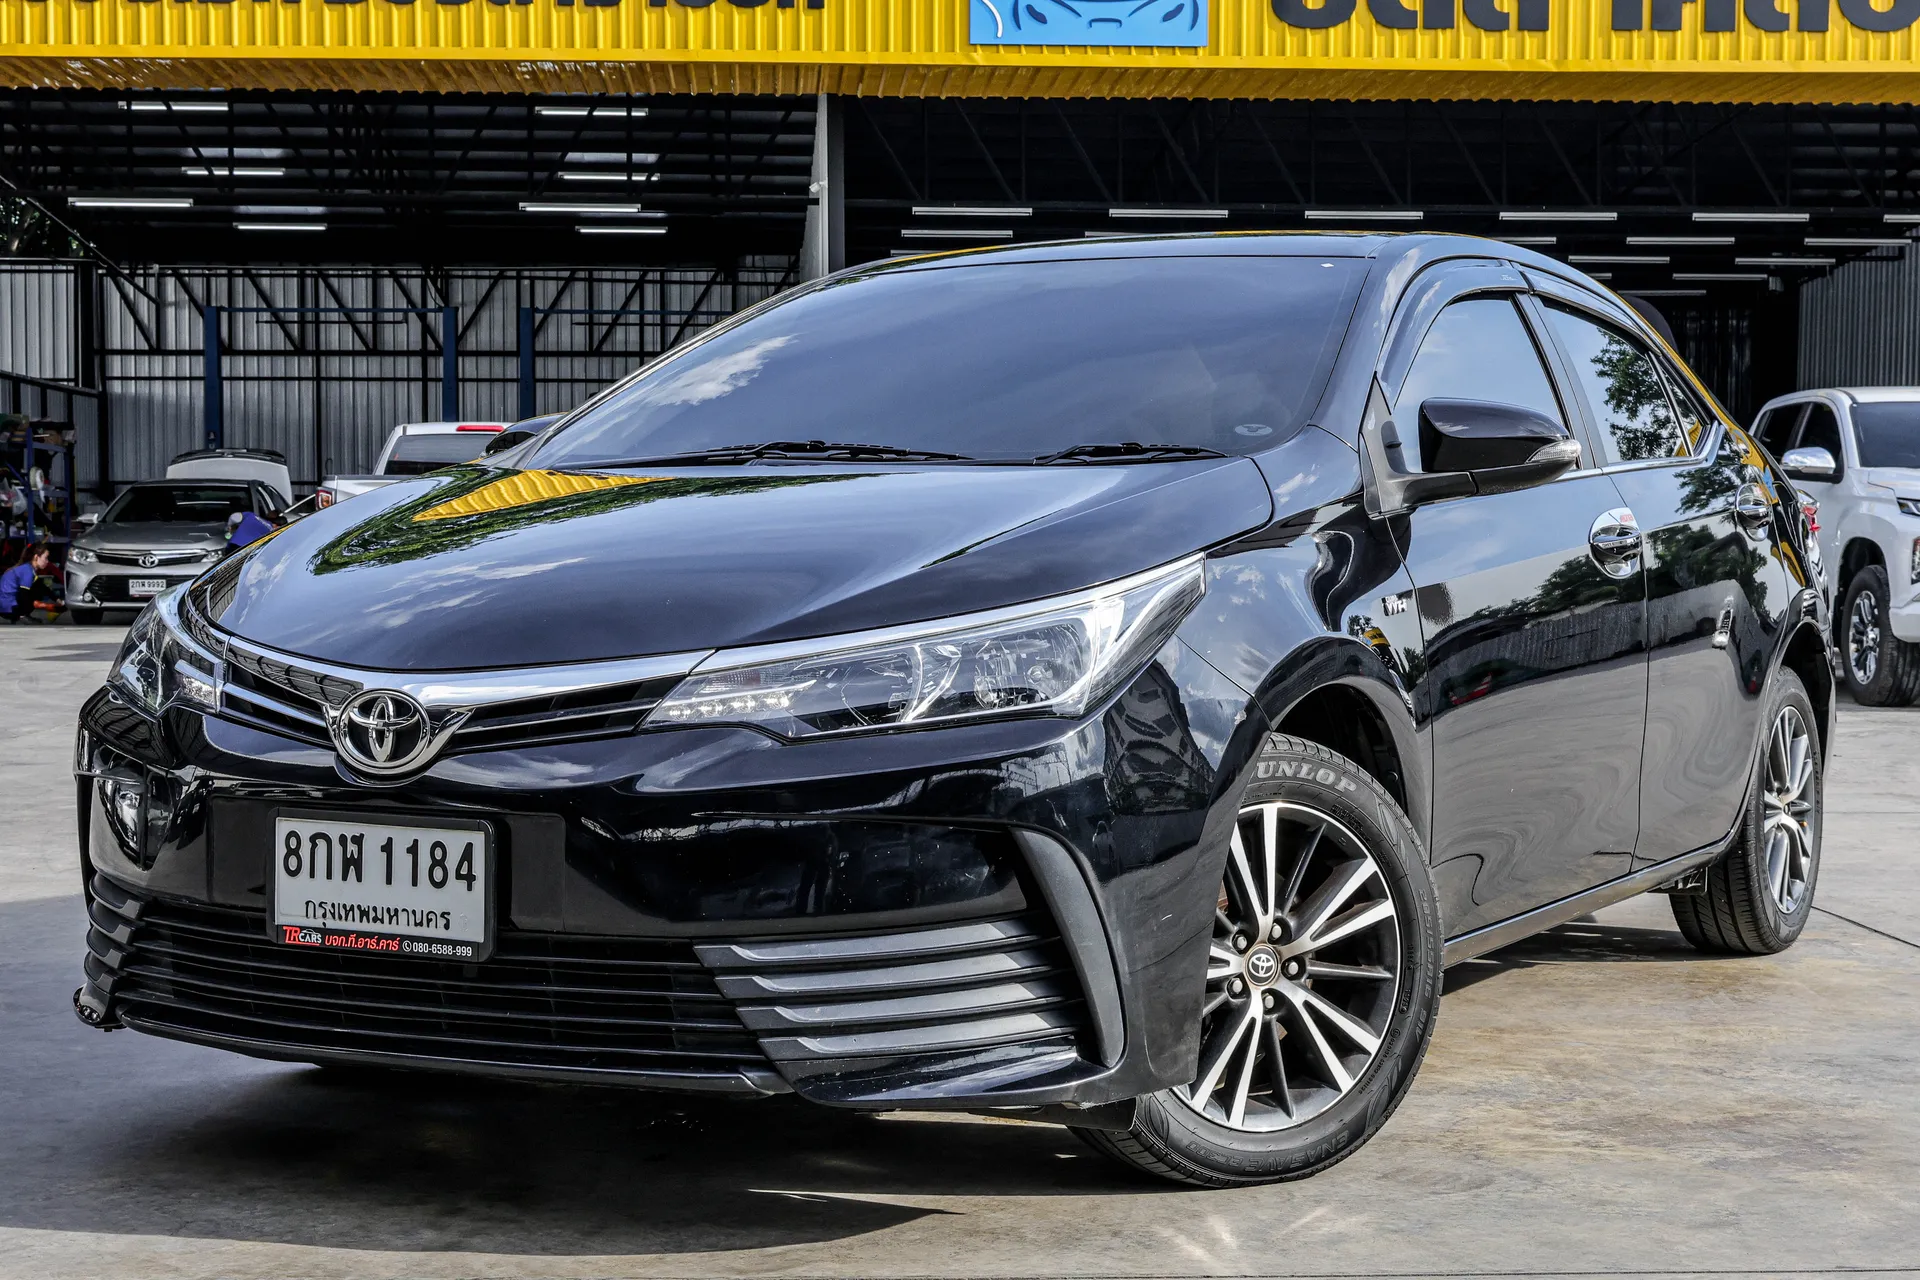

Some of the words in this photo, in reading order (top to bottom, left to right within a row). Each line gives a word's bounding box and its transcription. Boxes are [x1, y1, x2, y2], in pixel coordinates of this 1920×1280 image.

[1256, 760, 1357, 793] UNLOP
[380, 836, 477, 891] 1184
[305, 899, 451, 931] กรุงเทพมหานคร
[412, 941, 473, 957] 080-6588-999
[1245, 1130, 1349, 1172] ENASAVE
